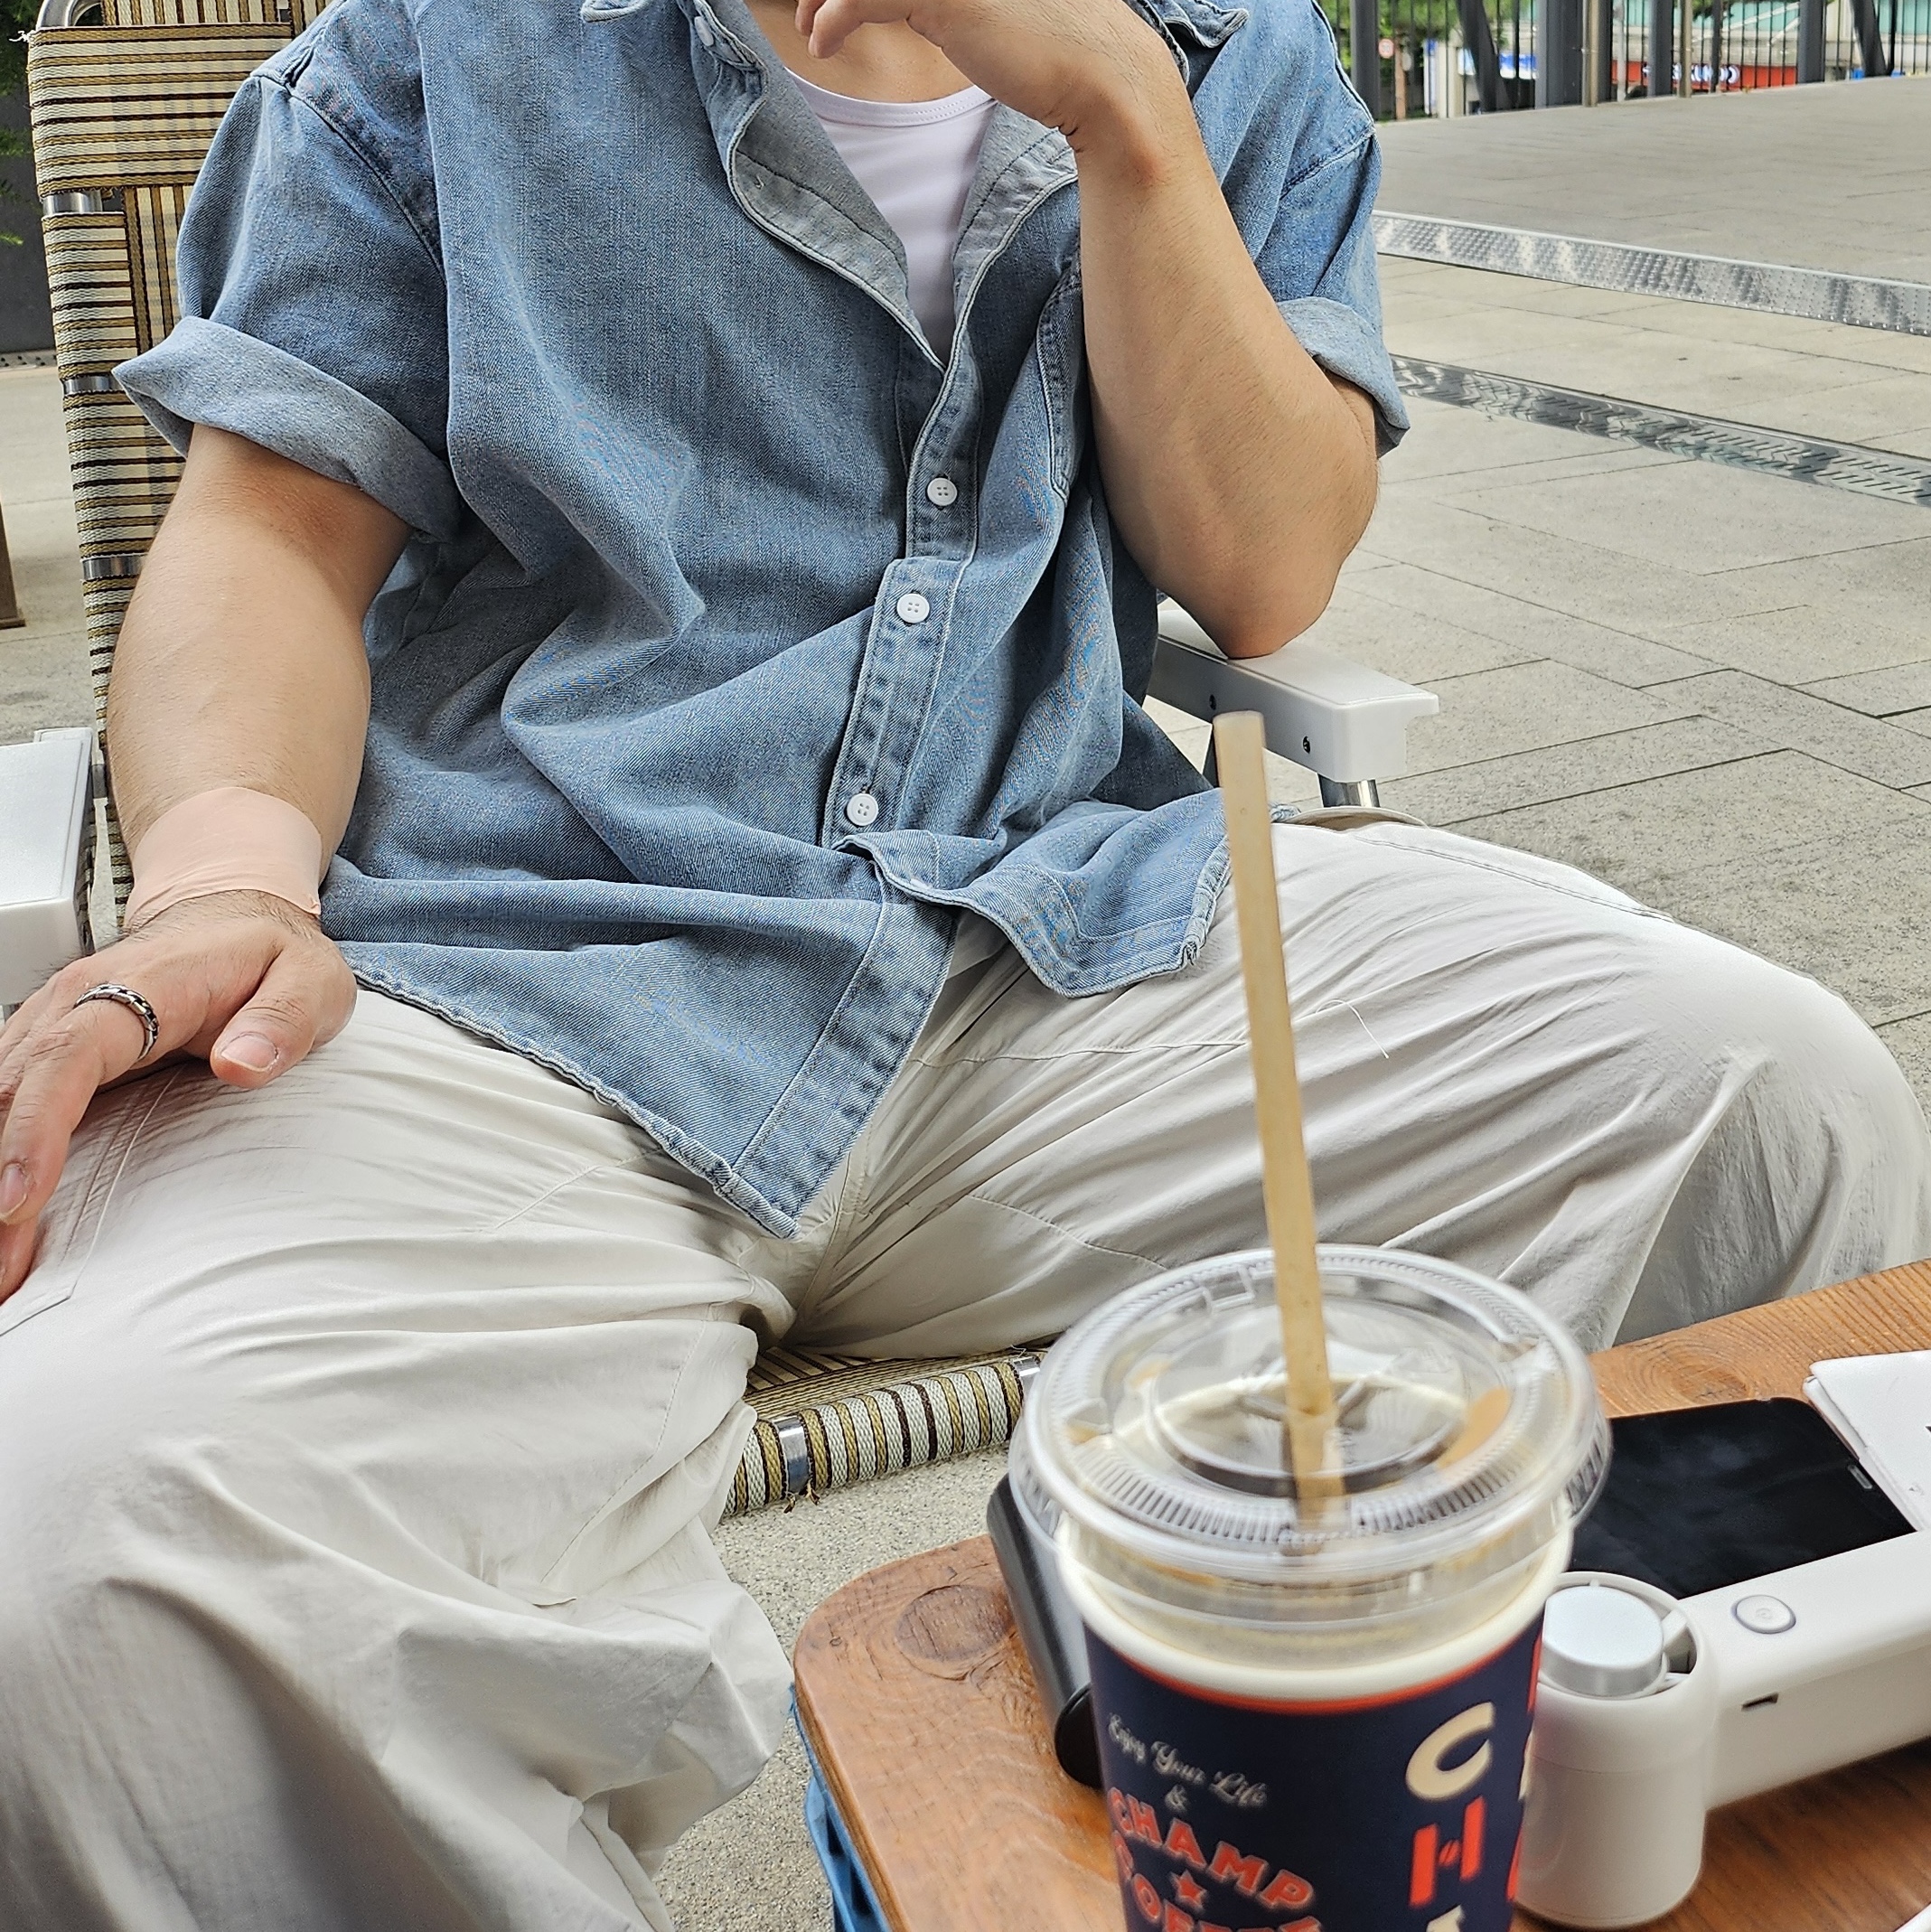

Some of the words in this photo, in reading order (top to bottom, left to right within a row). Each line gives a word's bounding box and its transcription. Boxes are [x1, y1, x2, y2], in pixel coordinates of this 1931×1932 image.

[1109, 1713, 1146, 1764] Enjoy
[1151, 1740, 1205, 1786] Your
[1209, 1771, 1267, 1806] Life
[1165, 1785, 1190, 1811] &
[1107, 1787, 1314, 1909] CHAMP
